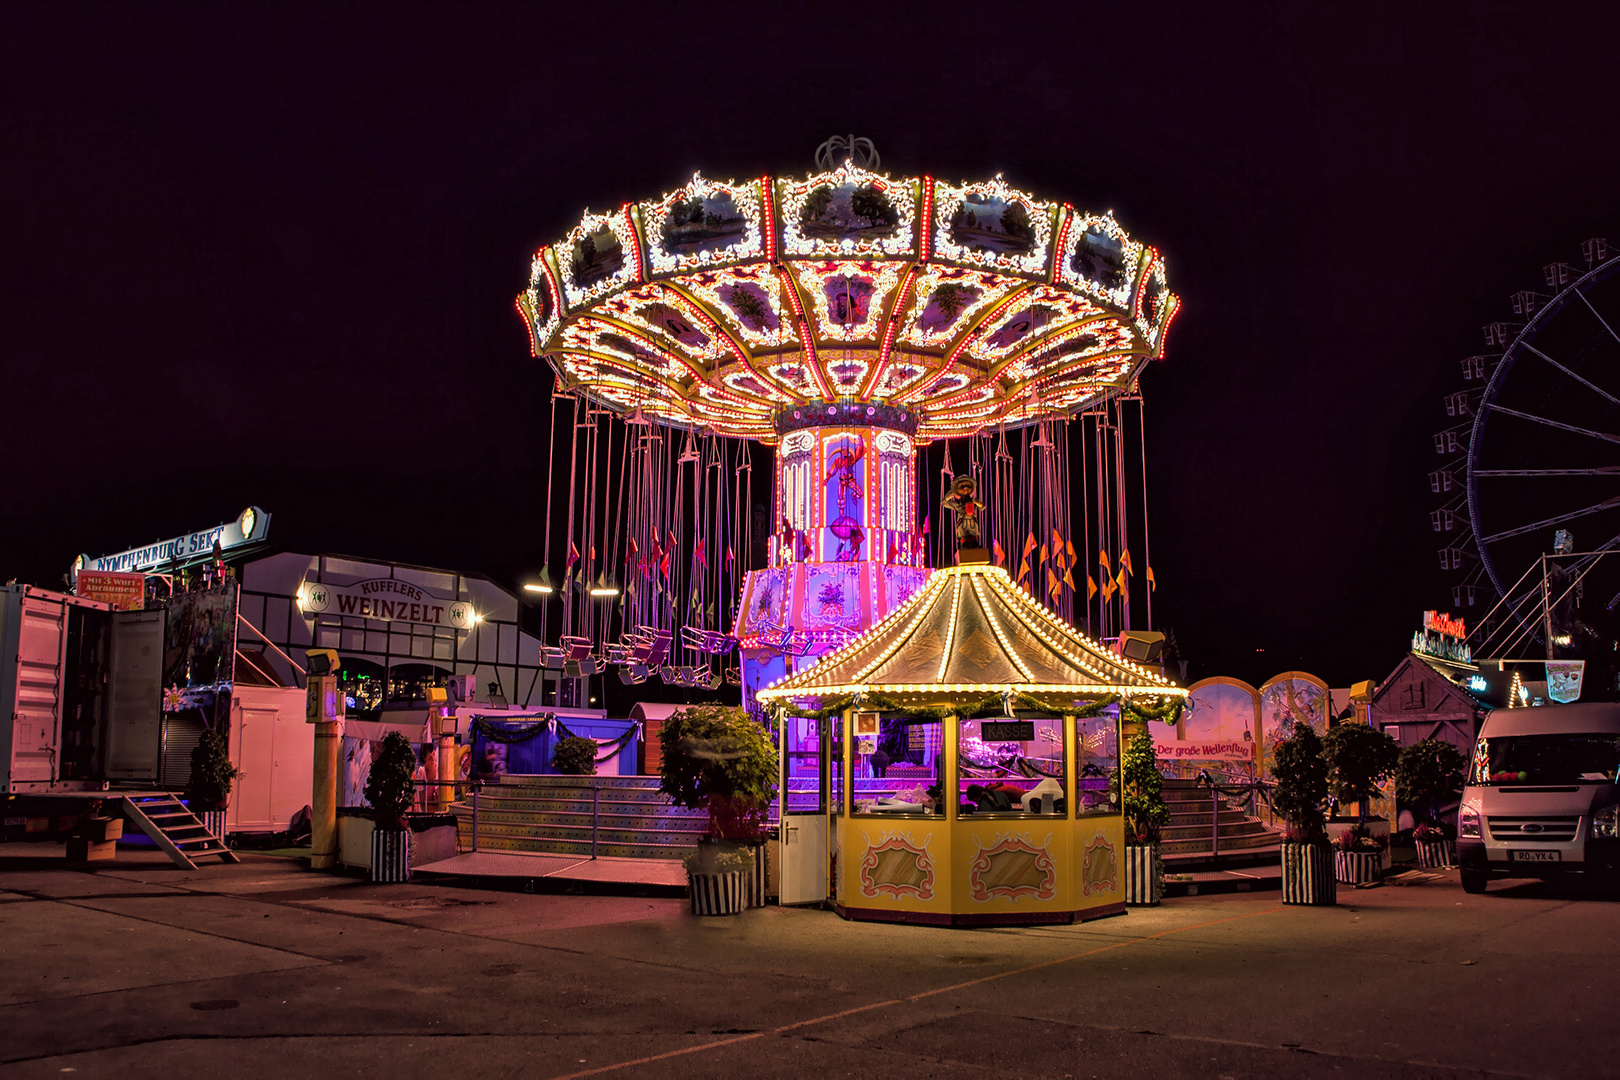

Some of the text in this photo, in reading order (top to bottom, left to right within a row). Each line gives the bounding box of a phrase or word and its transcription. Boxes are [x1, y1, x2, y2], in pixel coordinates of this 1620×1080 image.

[103, 577, 112, 585] 3
[113, 578, 136, 586] Wurf
[361, 581, 423, 601] KUFFLERS
[336, 594, 445, 624] WEINZELT
[988, 724, 1029, 738] KASSE
[1157, 744, 1174, 754] Der
[1175, 745, 1201, 757] große
[1202, 742, 1250, 757] Wellenflug
[1519, 852, 1531, 861] RO
